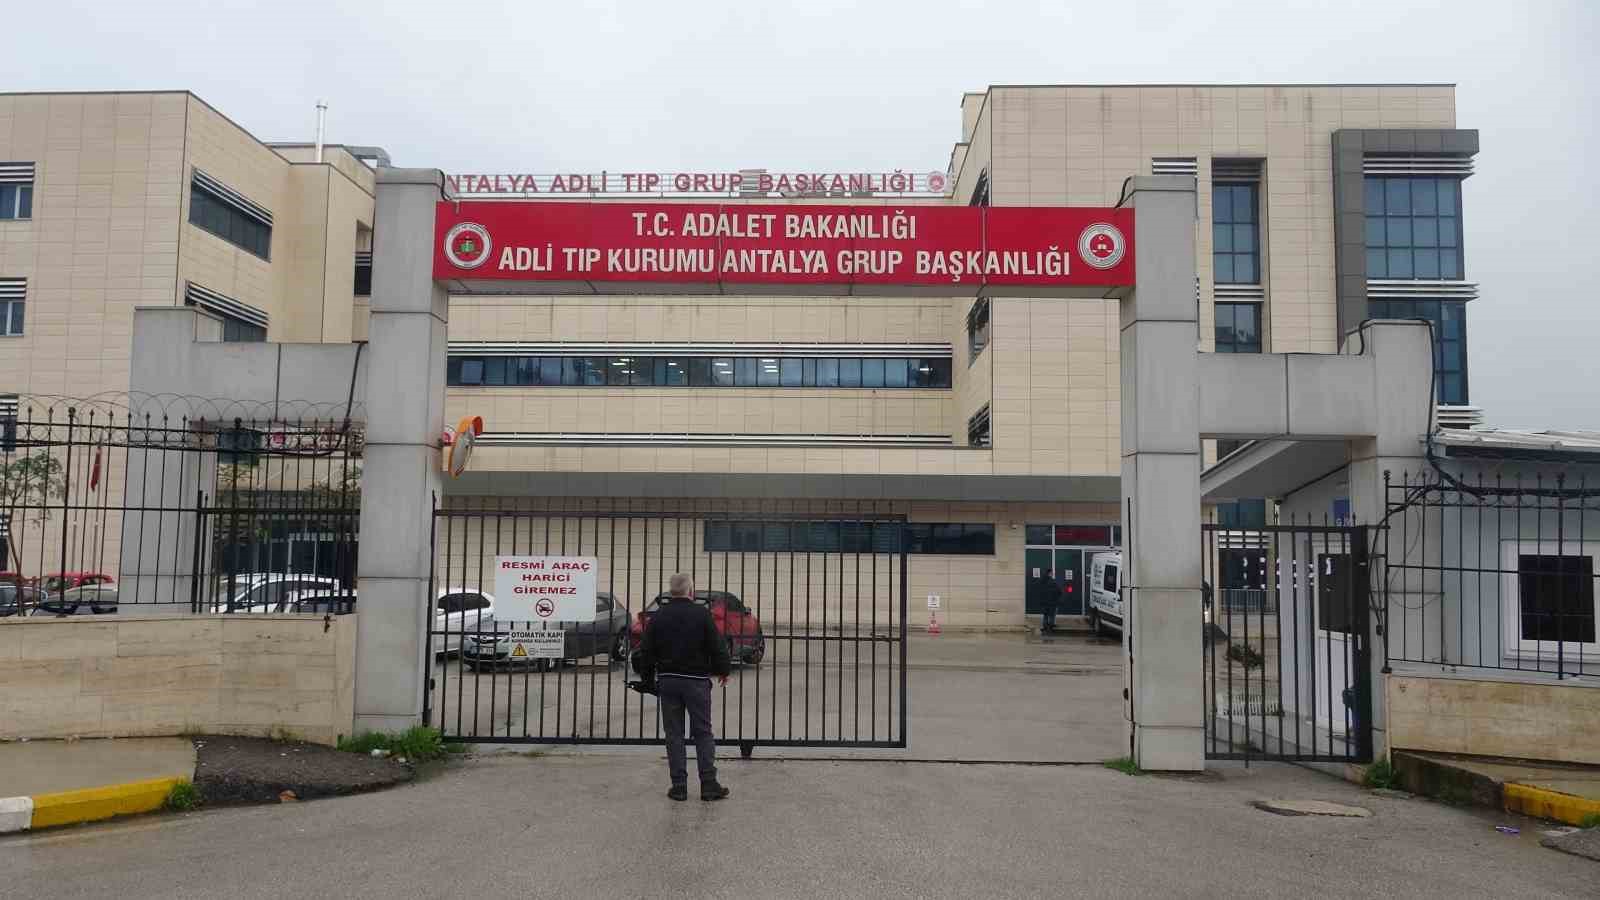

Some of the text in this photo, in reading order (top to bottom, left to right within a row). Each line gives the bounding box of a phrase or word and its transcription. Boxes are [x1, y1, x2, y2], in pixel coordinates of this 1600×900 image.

[446, 169, 915, 195] NTALYA ADLİ TIP GRUP BAŞKANLIĞI
[632, 209, 917, 240] T.C. ADALET BAKANLIĞI
[498, 242, 553, 271] ADLİ
[562, 247, 601, 272] TIP
[607, 248, 715, 273] KURUMU
[722, 249, 828, 275] ANTALYA
[837, 250, 903, 274] GRUP
[915, 245, 1071, 282] BAŞKANLIĞI
[502, 560, 591, 572] RESMİ ARAÇ
[522, 573, 571, 582] HARİCİ
[513, 585, 577, 595] GİREMEZ
